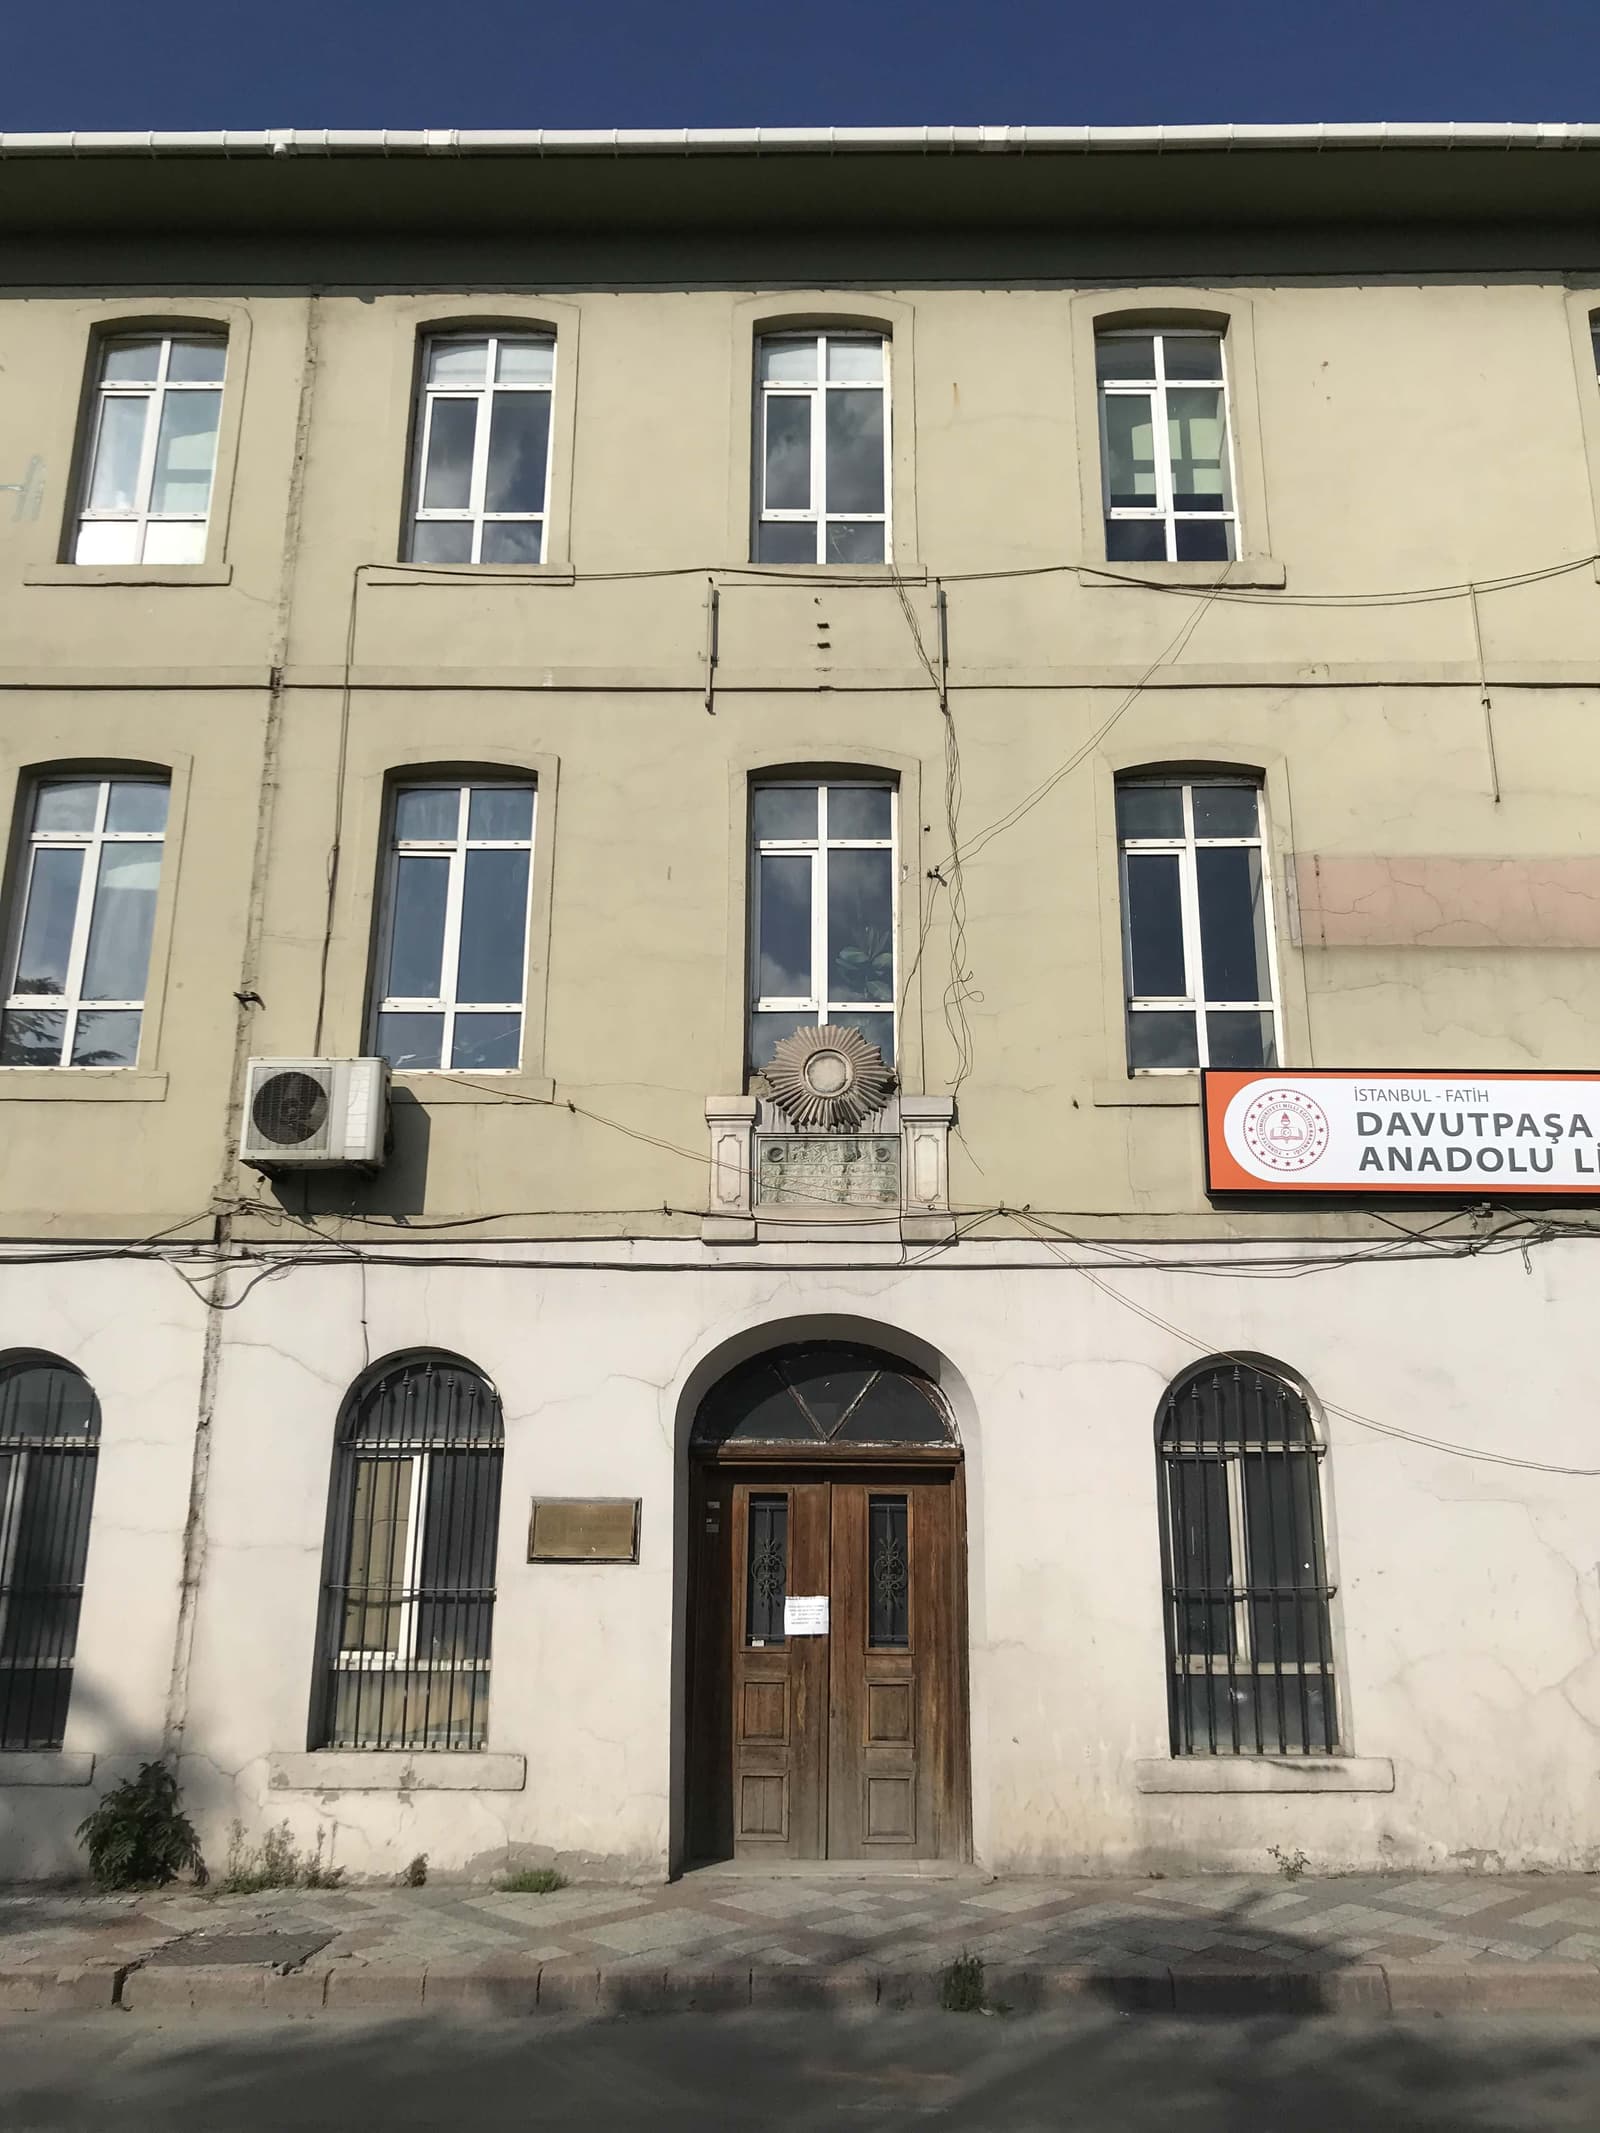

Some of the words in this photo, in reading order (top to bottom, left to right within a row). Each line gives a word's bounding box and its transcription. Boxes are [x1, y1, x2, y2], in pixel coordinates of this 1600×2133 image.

[1354, 1086, 1432, 1102] İSTANBUL
[1446, 1087, 1489, 1102] FATİH
[1356, 1111, 1594, 1145] DAVUTPAŞA
[1358, 1146, 1554, 1173] ANADOLU
